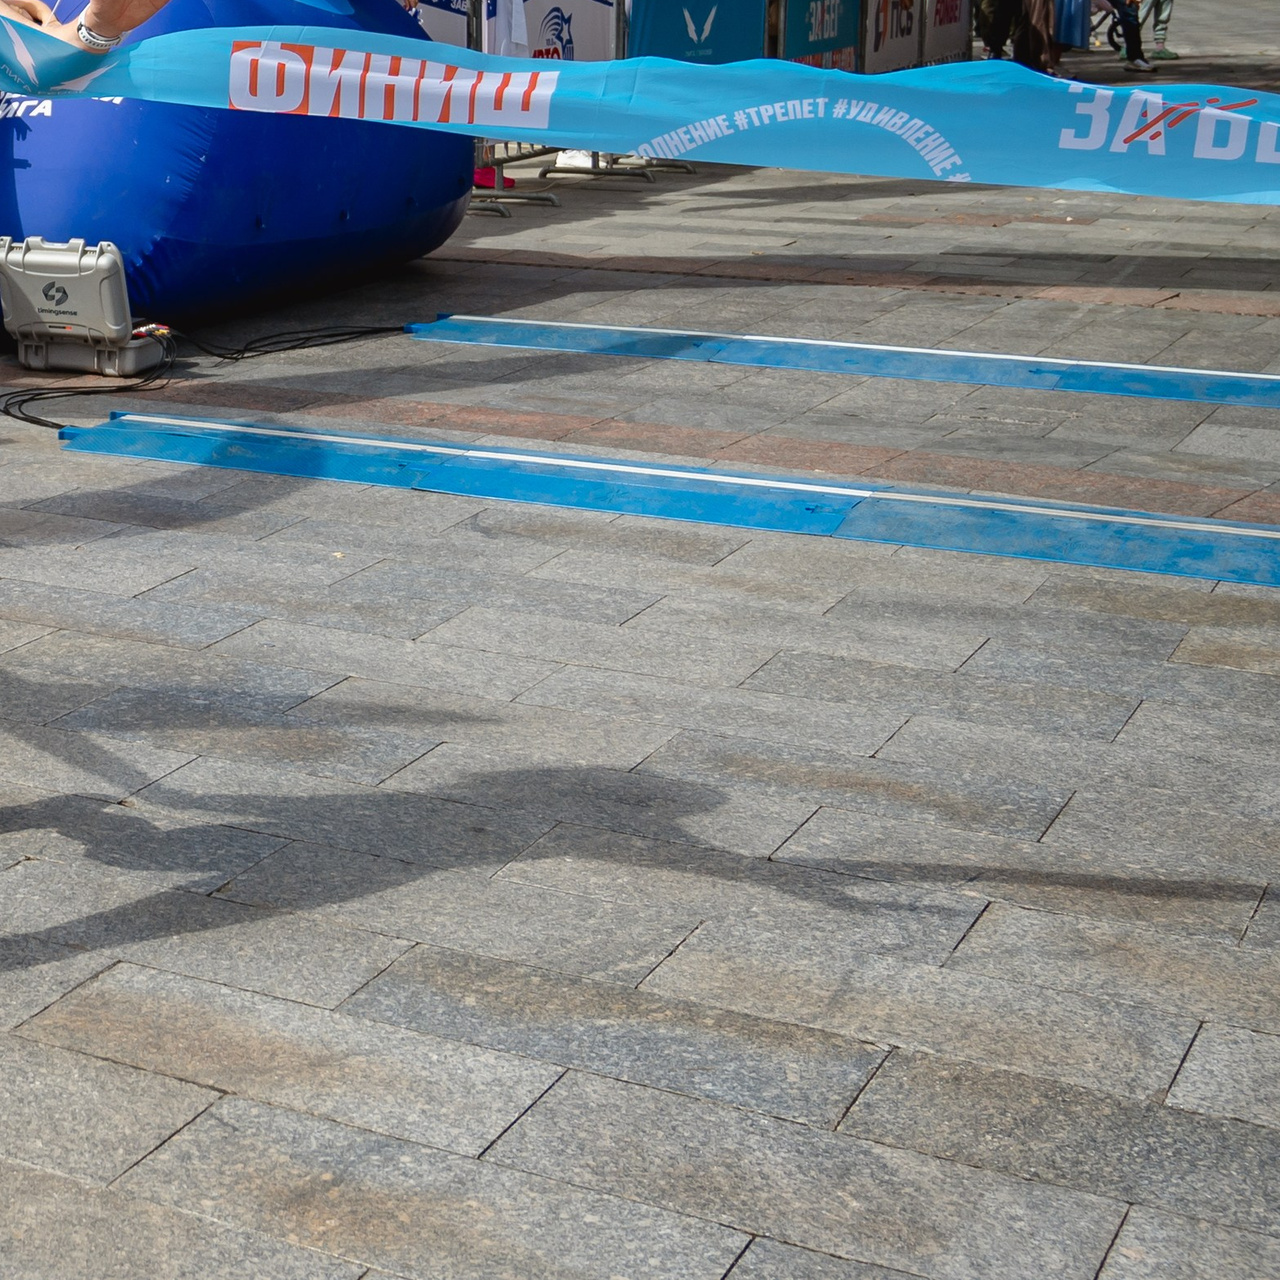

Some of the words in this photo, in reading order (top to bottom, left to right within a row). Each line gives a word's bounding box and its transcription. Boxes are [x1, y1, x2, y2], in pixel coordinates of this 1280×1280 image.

[228, 40, 561, 130] ФИНИШ
[733, 97, 829, 131] #ТРЕПЕТ
[832, 98, 970, 177] #УДИВЛЕНИЕ
[37, 307, 78, 317] timingsense
